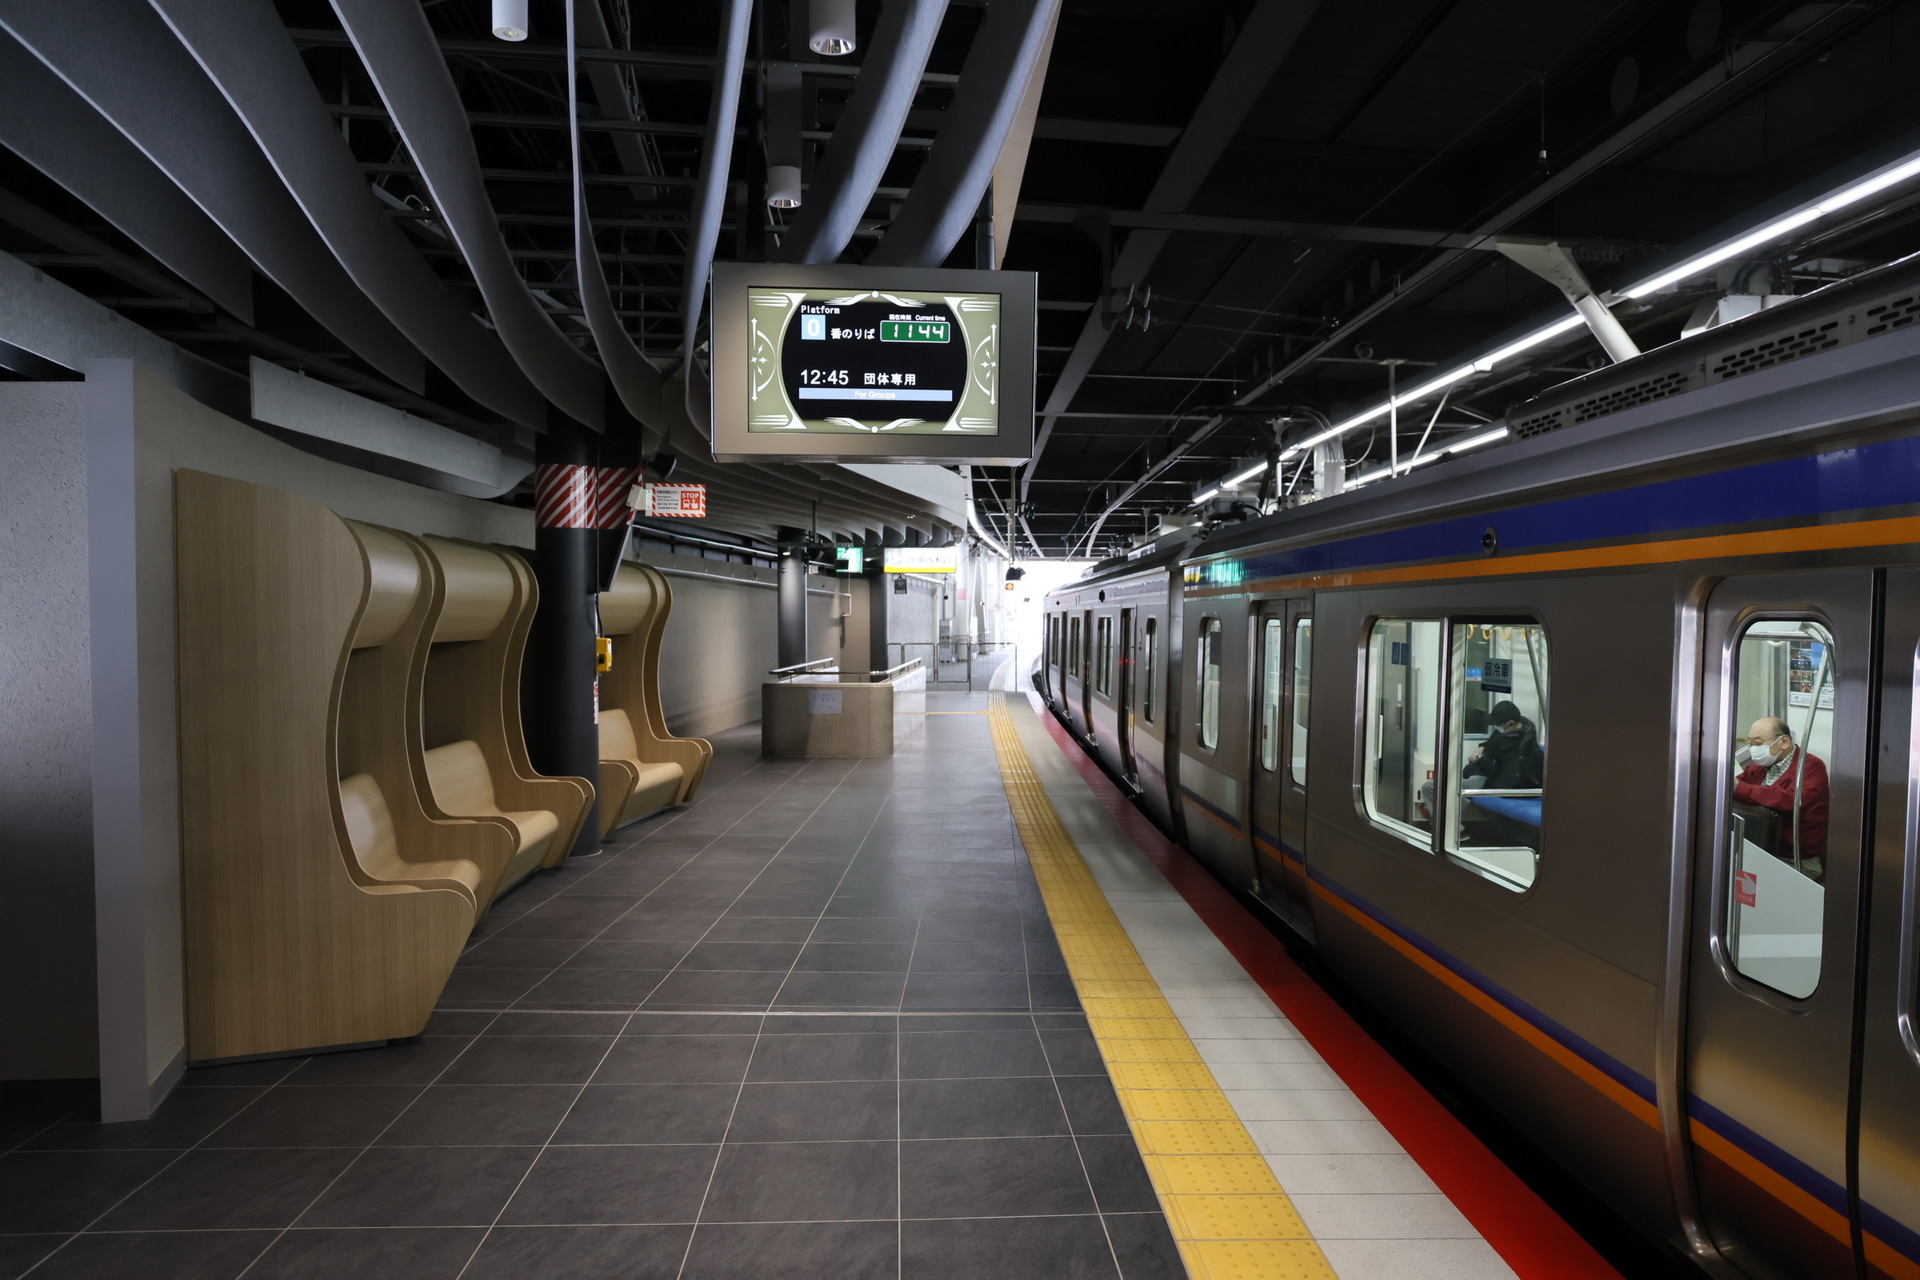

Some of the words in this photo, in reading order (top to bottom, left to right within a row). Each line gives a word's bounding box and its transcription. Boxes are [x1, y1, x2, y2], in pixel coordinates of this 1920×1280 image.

[800, 305, 840, 315] Platform
[915, 314, 934, 322] Current
[807, 318, 820, 337] 0
[830, 328, 875, 340] 番のりば
[800, 369, 849, 386] 12:45
[864, 372, 916, 386] 団体専用
[854, 391, 867, 399] For
[868, 391, 896, 400] Groups
[1484, 661, 1509, 679] 弱冷車
